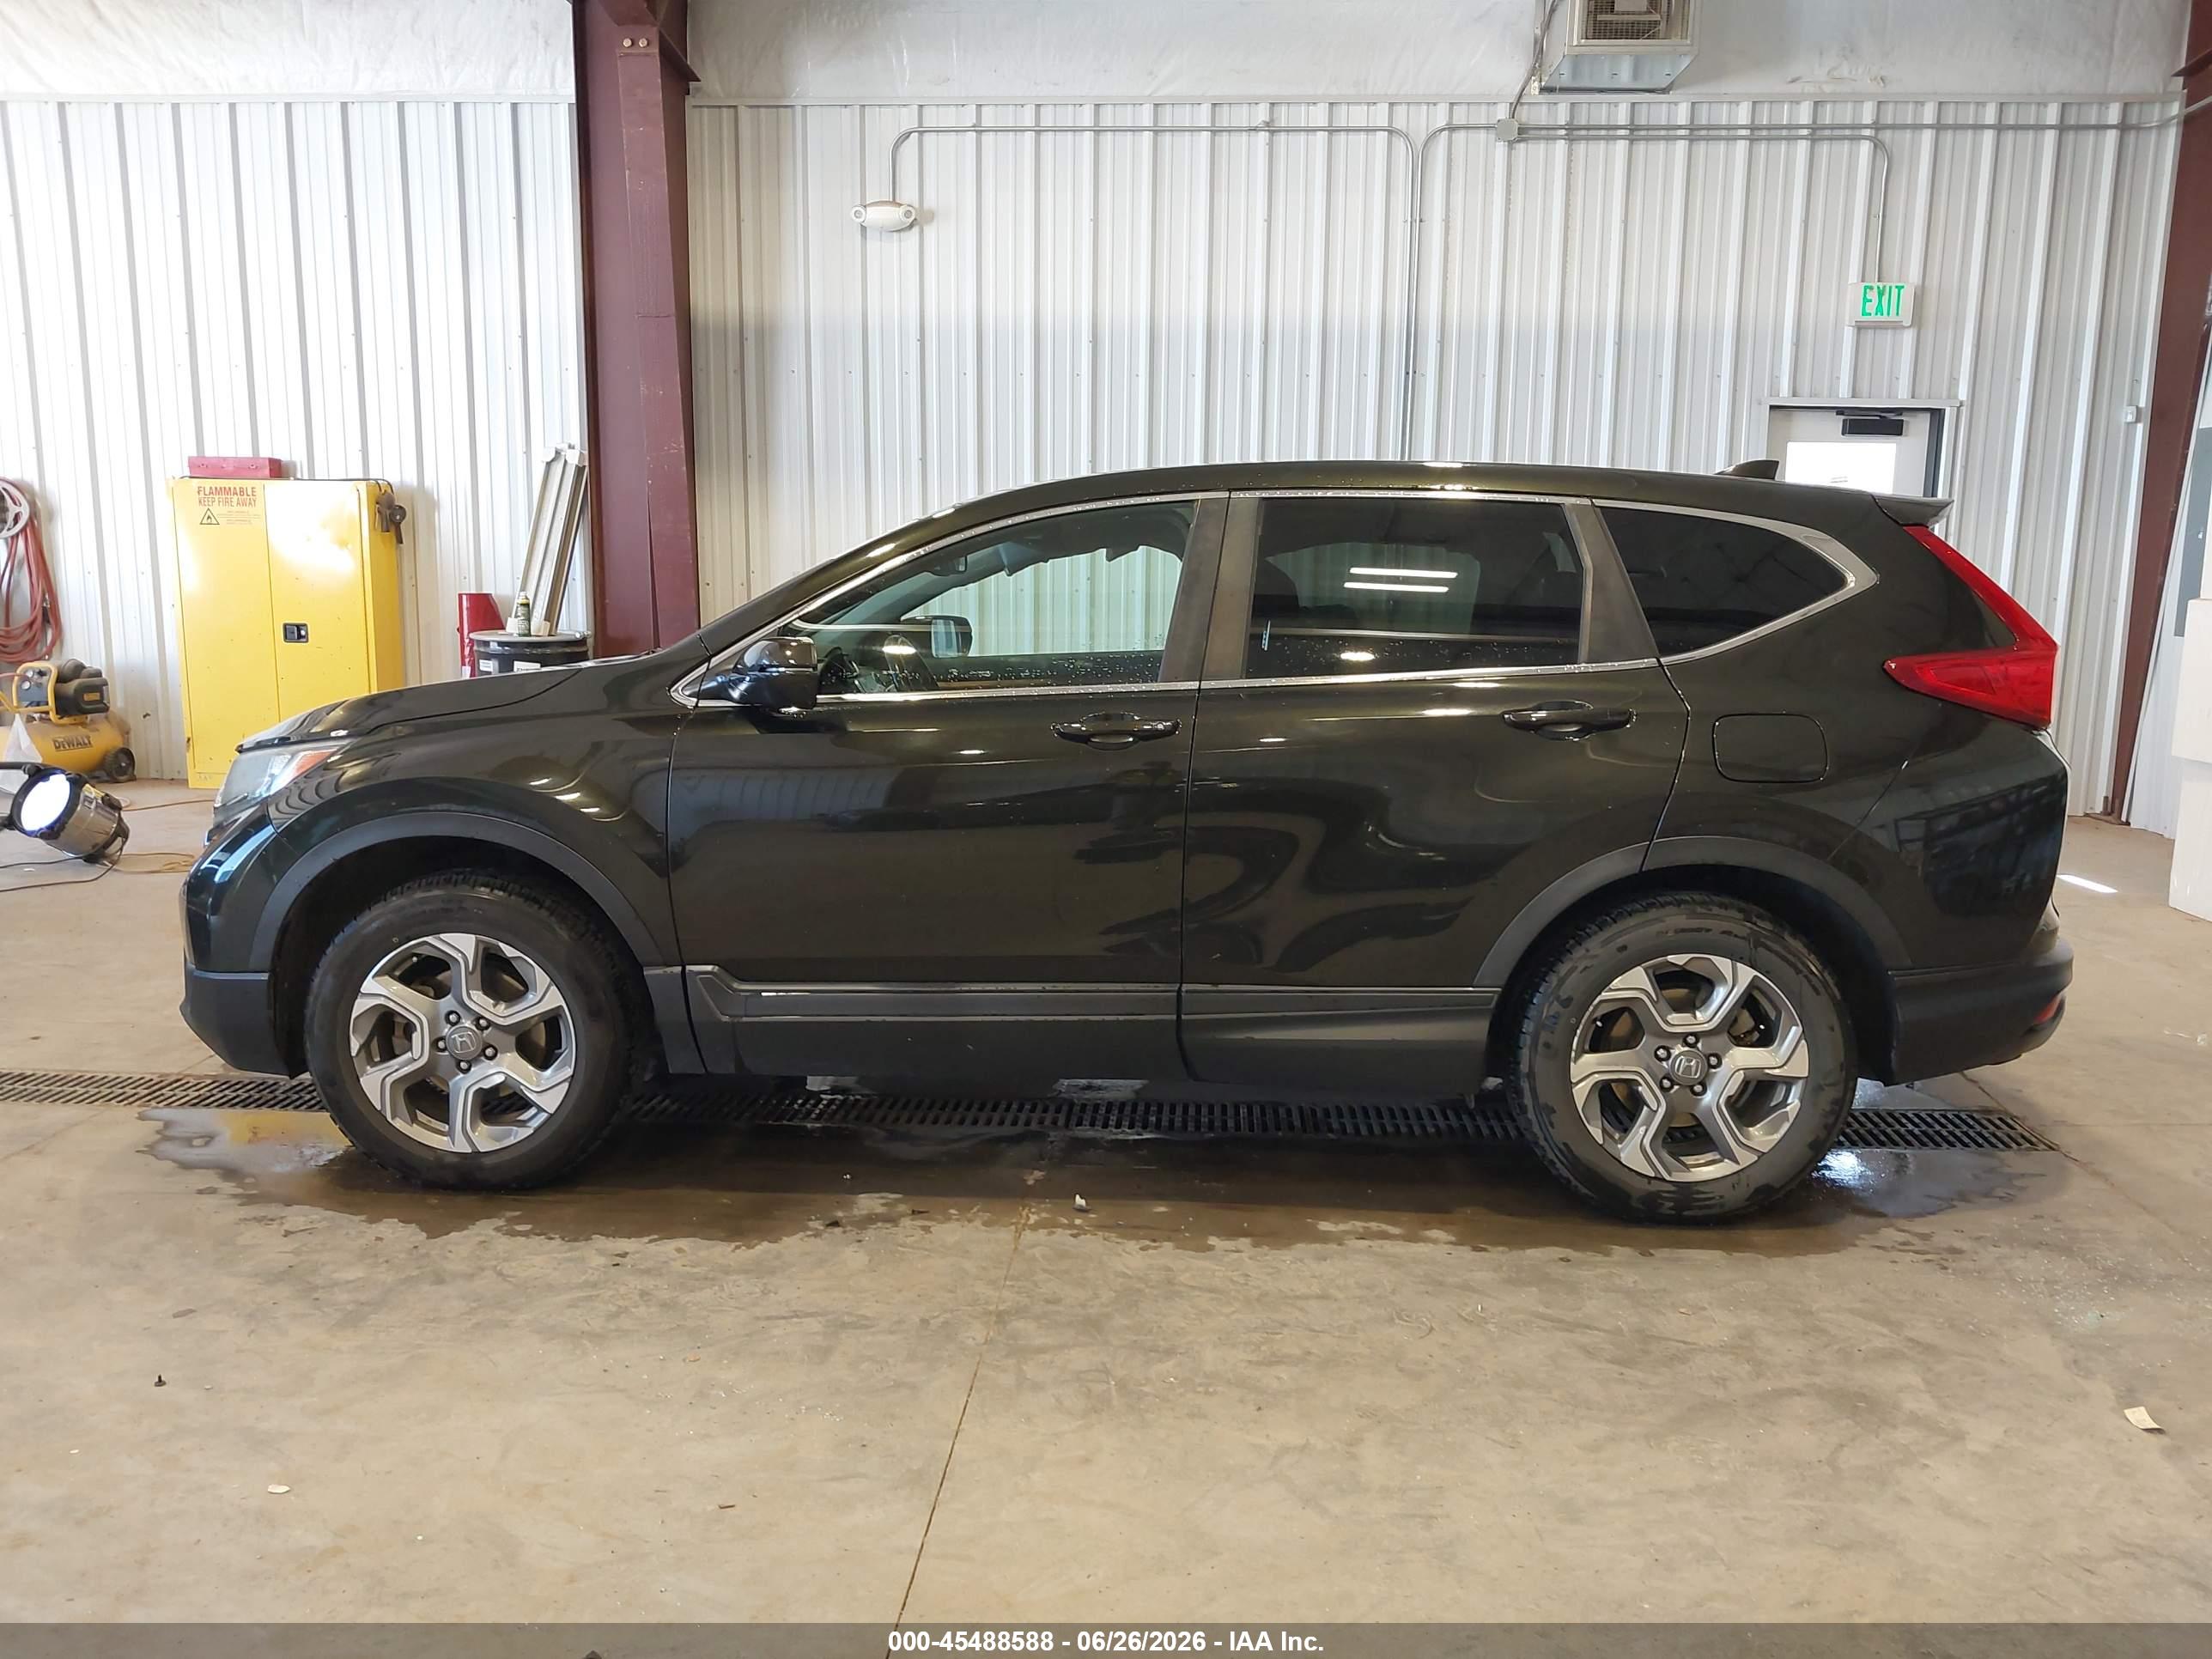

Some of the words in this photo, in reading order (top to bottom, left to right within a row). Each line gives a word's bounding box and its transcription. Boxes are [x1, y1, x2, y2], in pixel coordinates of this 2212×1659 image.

[1861, 284, 1905, 317] EXIT
[198, 486, 257, 496] FLAMMABLE
[198, 497, 216, 507] KEEP
[218, 497, 234, 507] FIRE
[236, 497, 257, 507] AWAY
